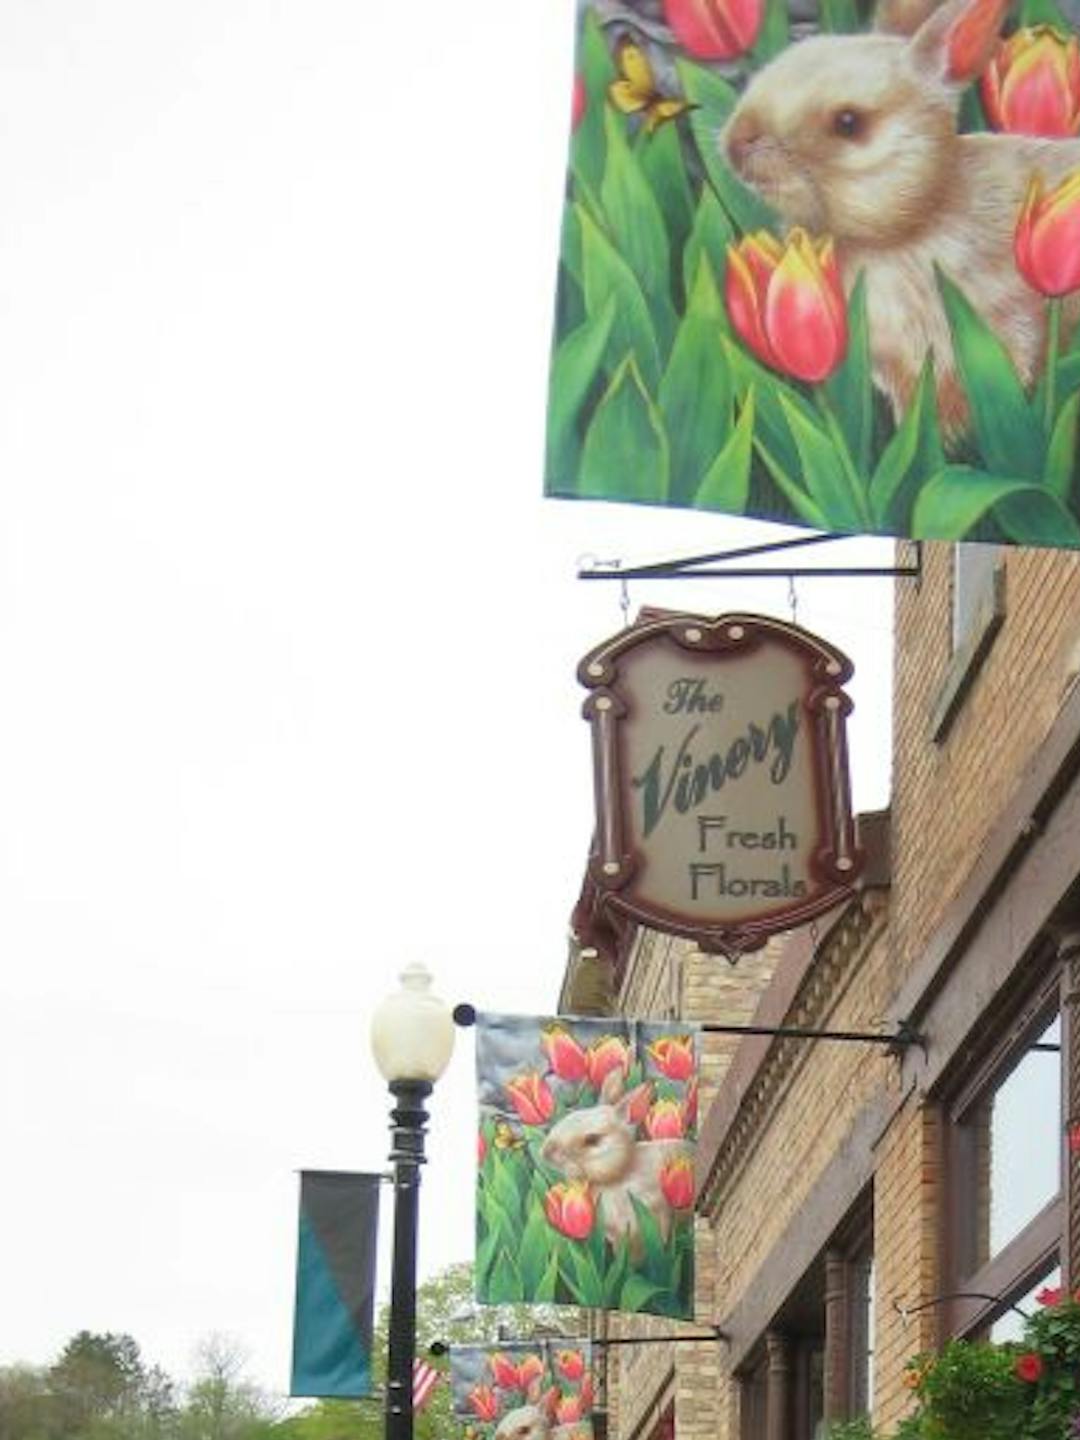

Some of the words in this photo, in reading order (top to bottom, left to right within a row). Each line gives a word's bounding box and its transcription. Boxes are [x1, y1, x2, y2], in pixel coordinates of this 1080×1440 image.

[662, 677, 725, 714] The
[633, 699, 799, 839] Vinery
[697, 816, 798, 852] Fresh
[688, 863, 807, 900] Florals
